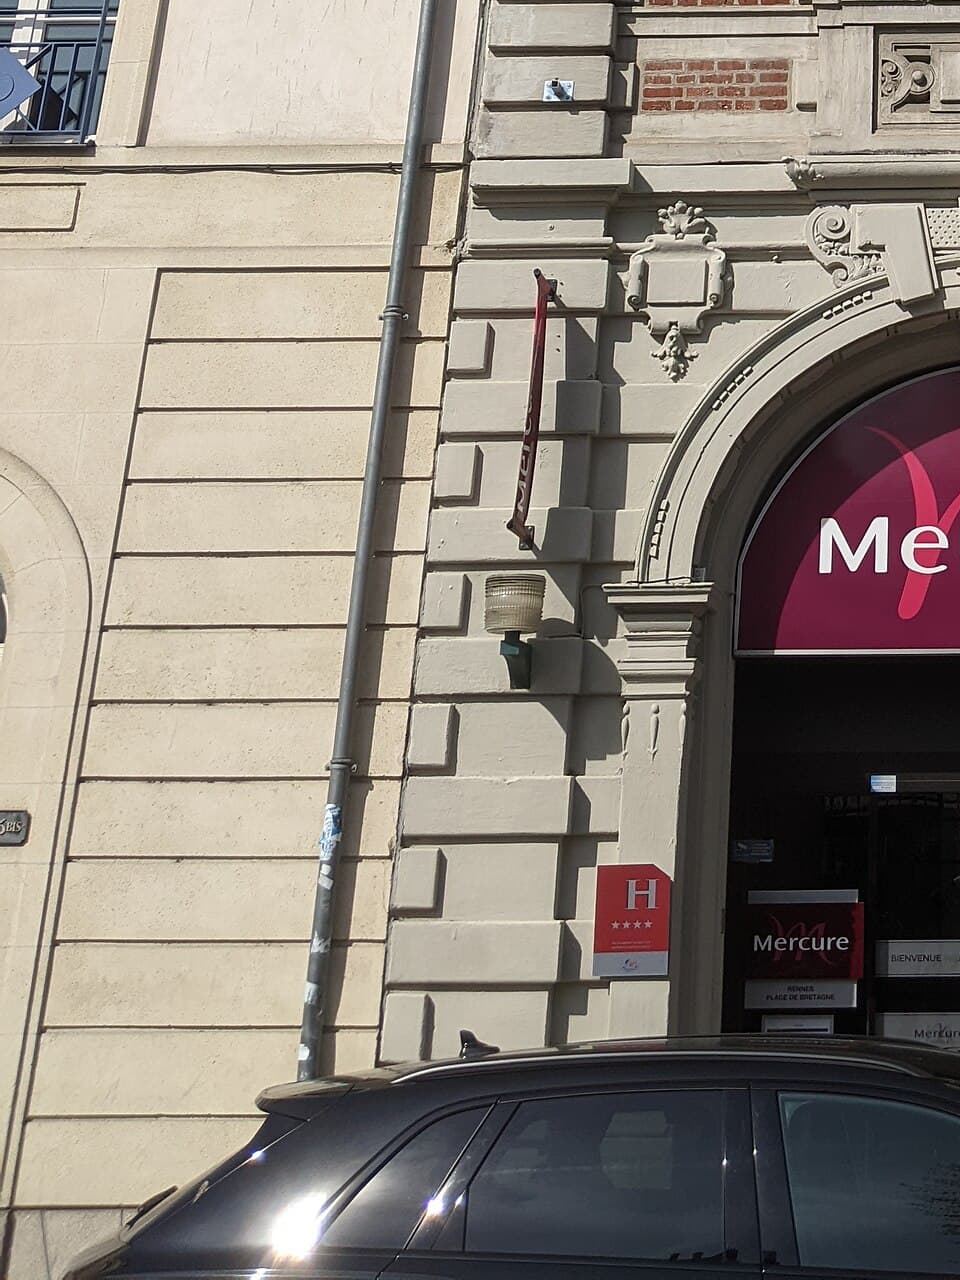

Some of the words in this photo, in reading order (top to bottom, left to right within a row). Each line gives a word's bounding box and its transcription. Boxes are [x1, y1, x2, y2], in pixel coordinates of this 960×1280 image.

[625, 879, 660, 910] H
[753, 935, 849, 951] Mercure
[891, 954, 942, 962] BIENVENUE
